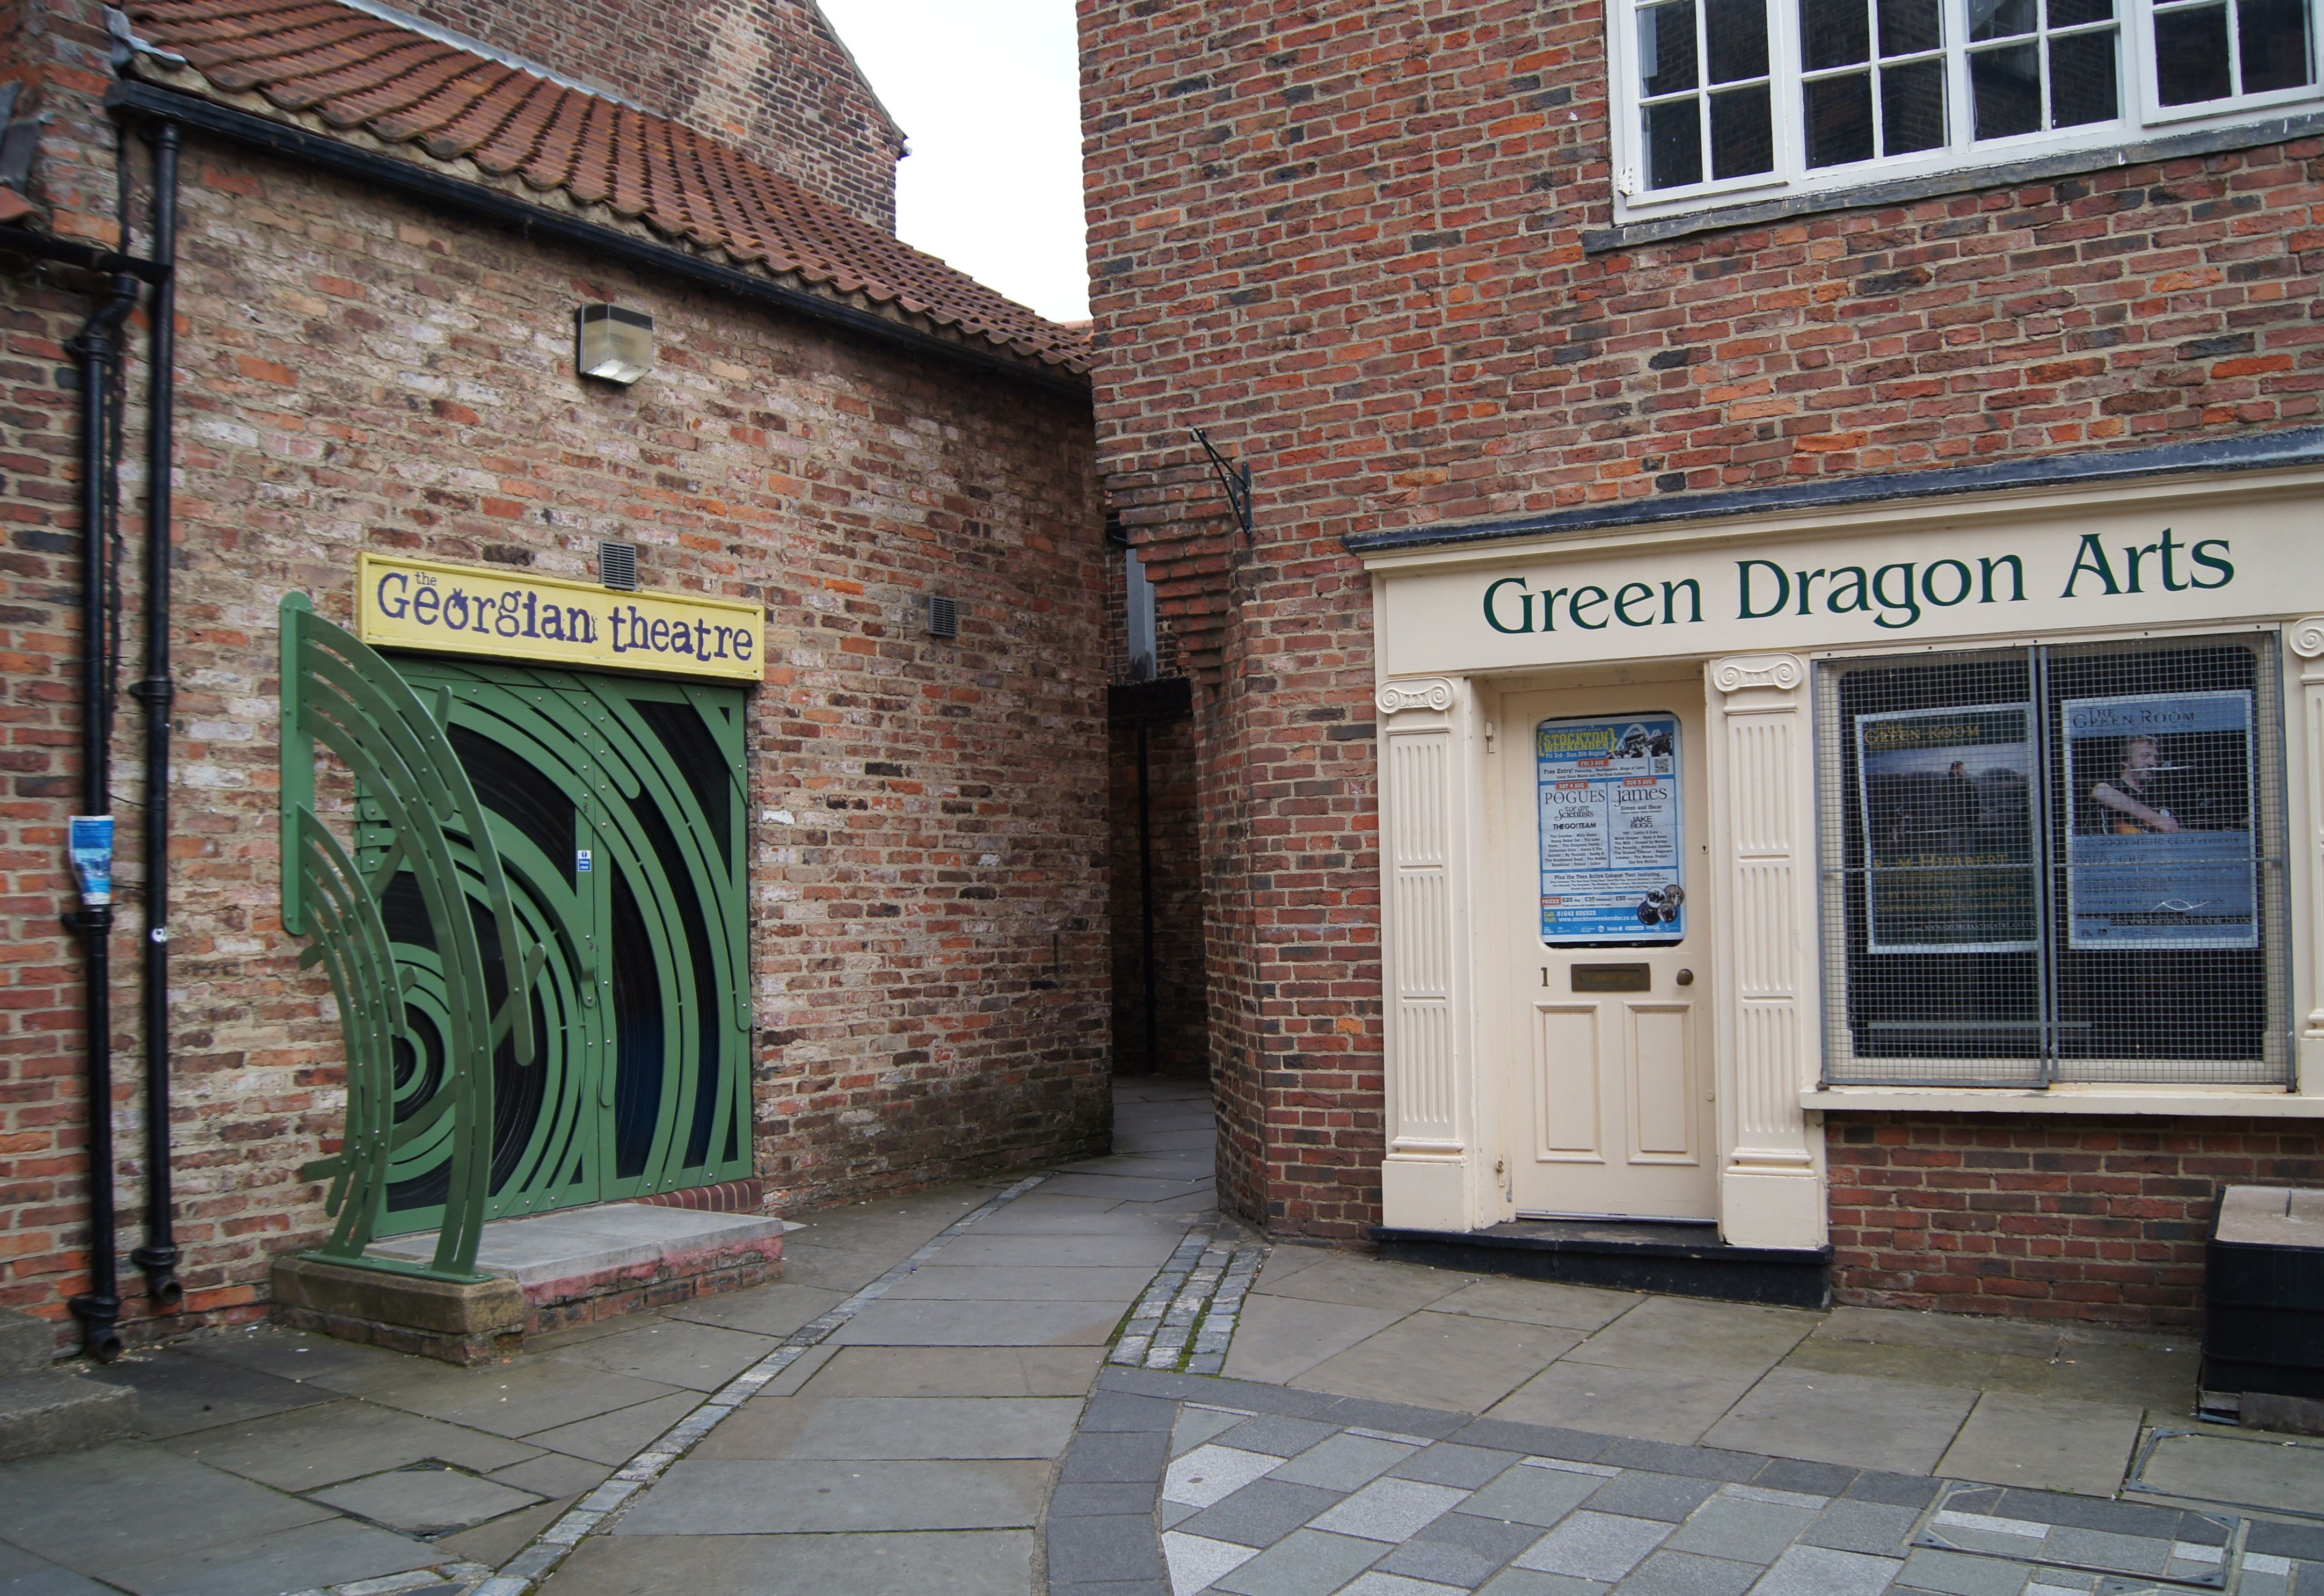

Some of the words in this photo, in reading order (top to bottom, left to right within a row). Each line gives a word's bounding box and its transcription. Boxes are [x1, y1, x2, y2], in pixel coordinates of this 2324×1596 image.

[413, 571, 437, 586] the
[1483, 576, 1704, 634] Green
[1735, 554, 2028, 629] Dragon
[2059, 528, 2234, 598] Arts
[378, 572, 598, 644] Georgian
[608, 605, 754, 662] theatre
[2140, 710, 2195, 724] ROOM
[1544, 731, 1608, 744] STOCKTON
[1928, 725, 1979, 739] ROOM
[1545, 741, 1608, 752] WEEKENDER
[1545, 789, 1605, 804] POGUES
[1613, 785, 1667, 807] james
[1555, 809, 1593, 821] Scientists
